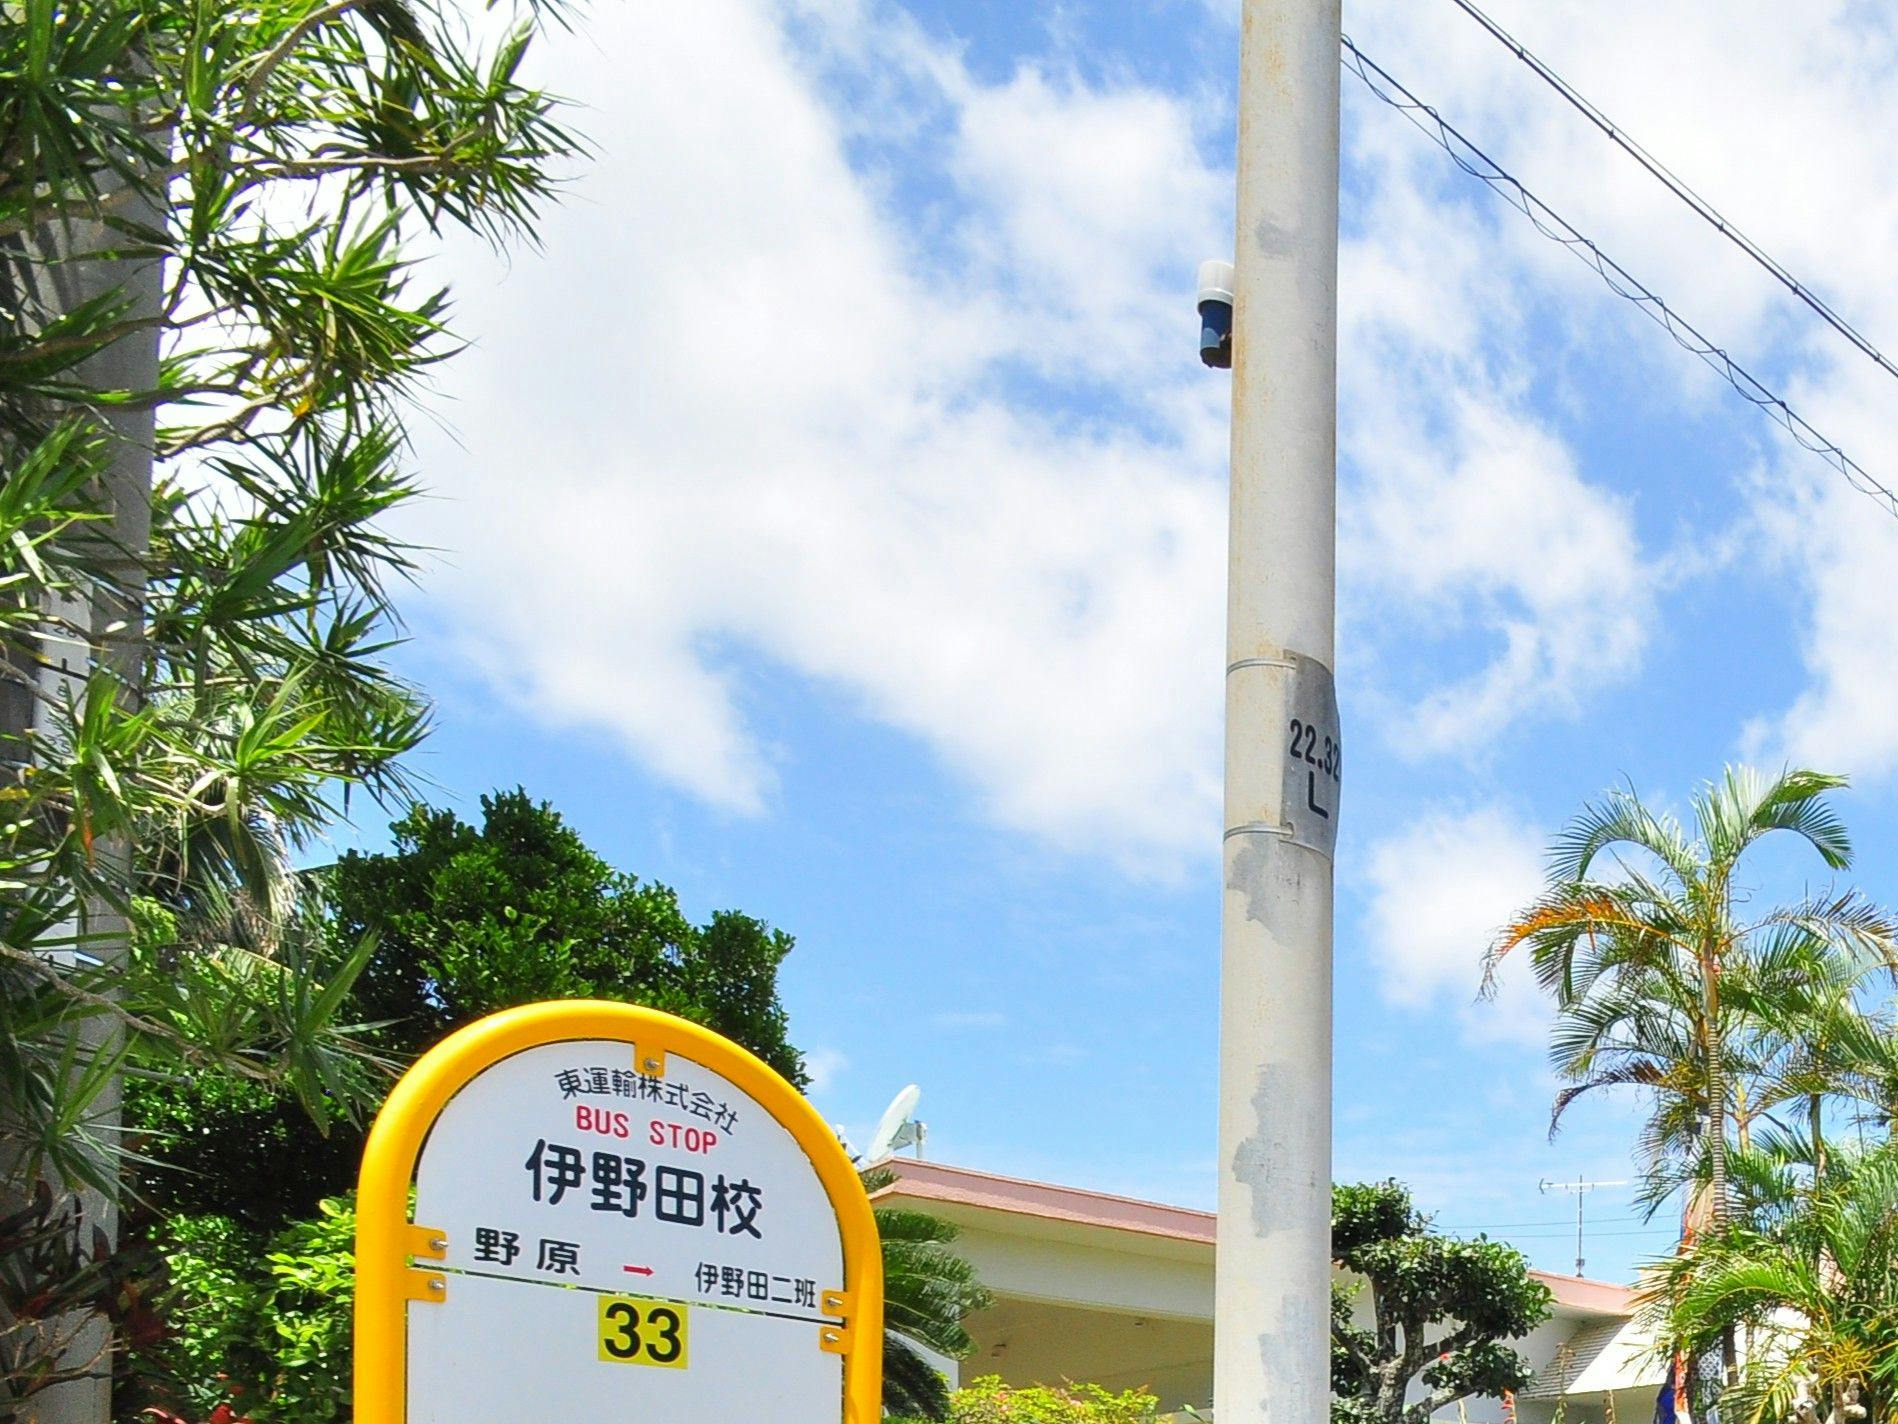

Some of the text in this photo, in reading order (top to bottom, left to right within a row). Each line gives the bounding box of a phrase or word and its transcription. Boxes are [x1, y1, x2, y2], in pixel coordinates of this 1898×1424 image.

[1308, 771, 1329, 819] L
[555, 1067, 739, 1136] 東運輸株式会社
[576, 1105, 717, 1155] BUS STOP
[525, 1139, 763, 1240] 伊野田校
[694, 1261, 817, 1309] 伊野田二班
[604, 1302, 682, 1363] 33
